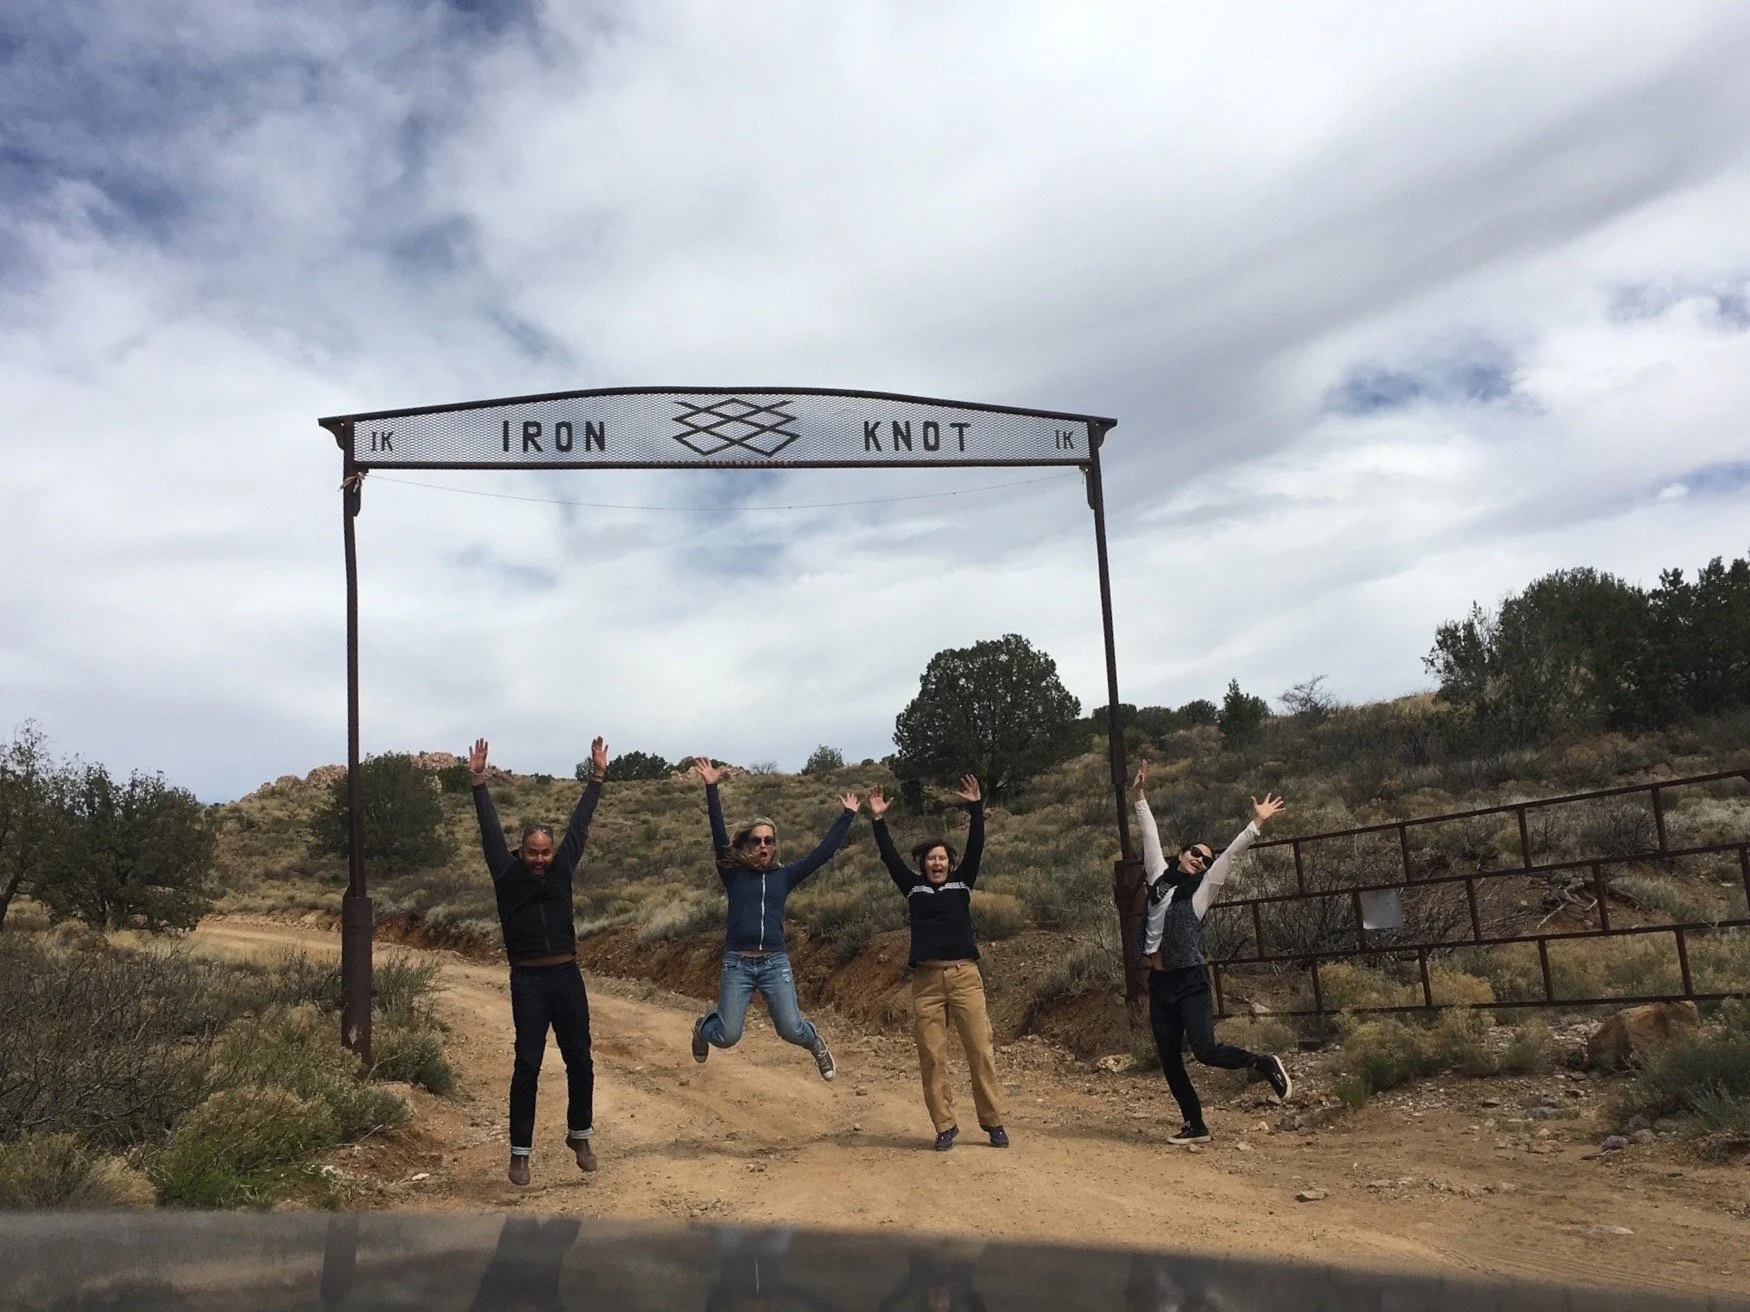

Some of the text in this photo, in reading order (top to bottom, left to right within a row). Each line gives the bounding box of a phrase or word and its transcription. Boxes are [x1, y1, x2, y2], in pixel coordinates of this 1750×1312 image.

[370, 431, 394, 452] IK
[502, 420, 971, 452] IRON KNOT
[1055, 429, 1076, 450] IK
